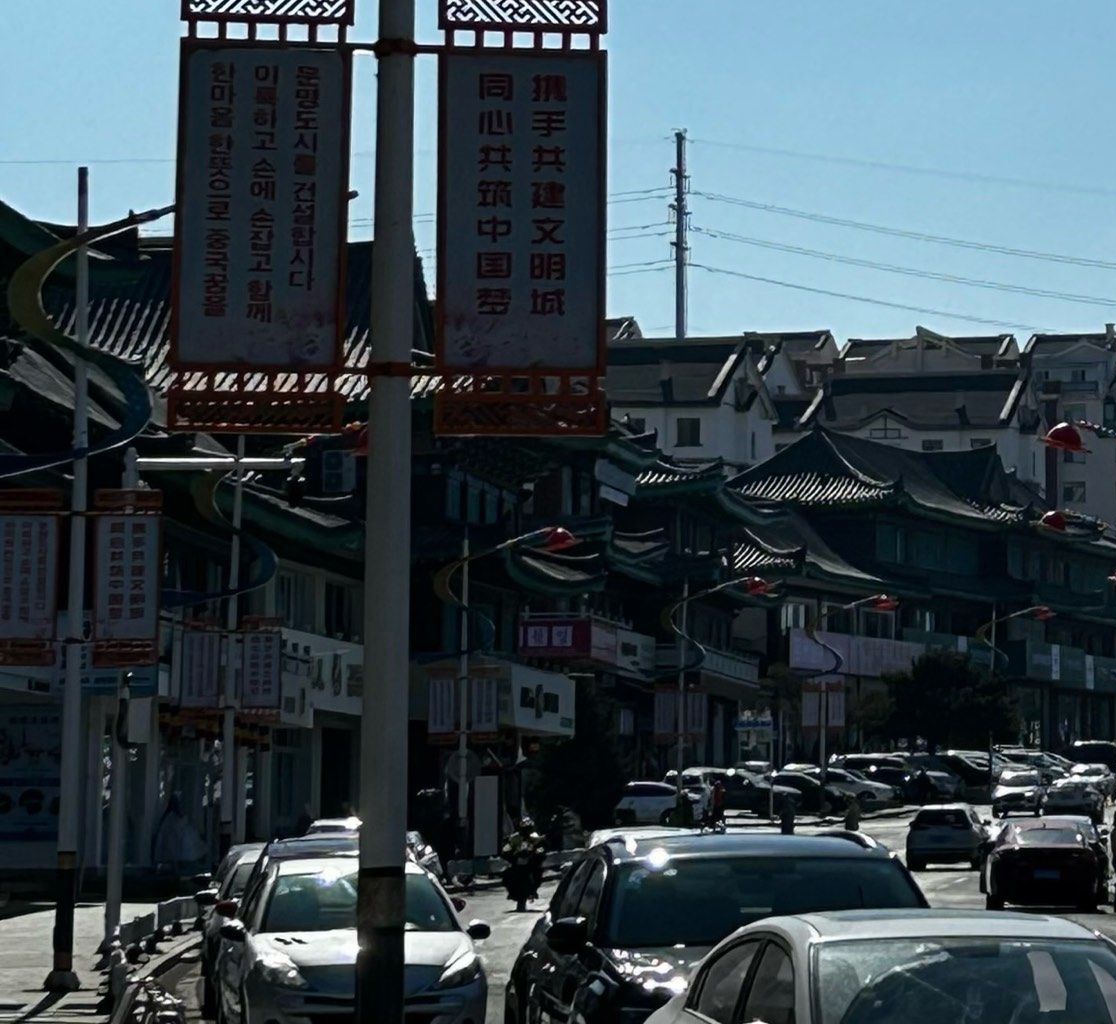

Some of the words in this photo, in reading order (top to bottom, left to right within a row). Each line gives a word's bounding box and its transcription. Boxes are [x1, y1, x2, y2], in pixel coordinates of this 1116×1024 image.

[209, 61, 236, 128] 한마음
[293, 65, 321, 176] 문명도시를
[205, 133, 234, 221] 한뜻으로
[250, 156, 278, 201] 손에
[477, 73, 513, 316] 同心共筑中国梦
[530, 74, 567, 316] 携手共建文明城
[247, 207, 275, 273] 손잡고
[289, 181, 317, 291] 건설합시다
[246, 279, 273, 323] 함께
